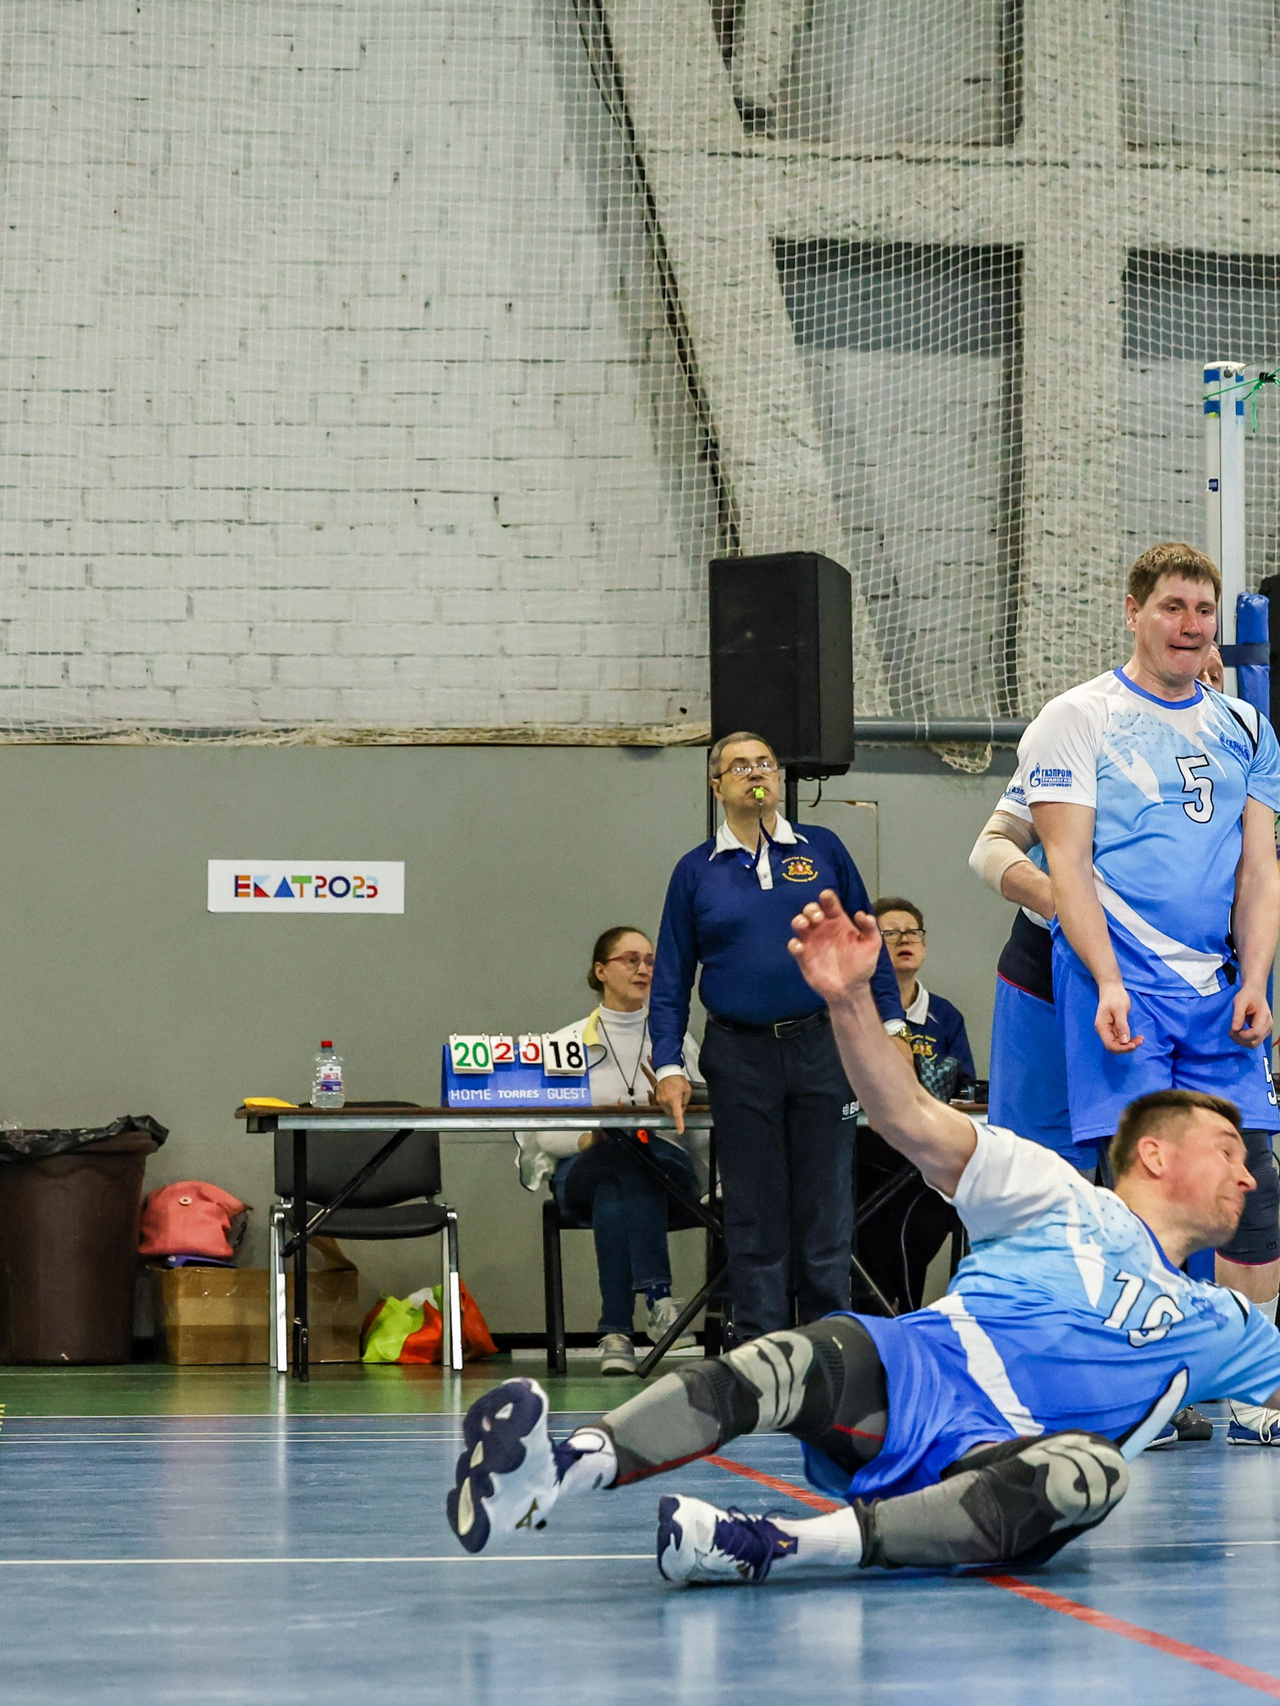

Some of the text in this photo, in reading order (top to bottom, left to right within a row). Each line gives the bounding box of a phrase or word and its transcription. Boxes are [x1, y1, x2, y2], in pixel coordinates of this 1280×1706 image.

[1041, 769, 1073, 778] ГАЗПРОМ
[1175, 754, 1214, 824] 5
[234, 875, 378, 898] EKAT2023
[454, 1041, 584, 1069] 20 2 0 18
[450, 1088, 588, 1101] HOME TORRES GUEST
